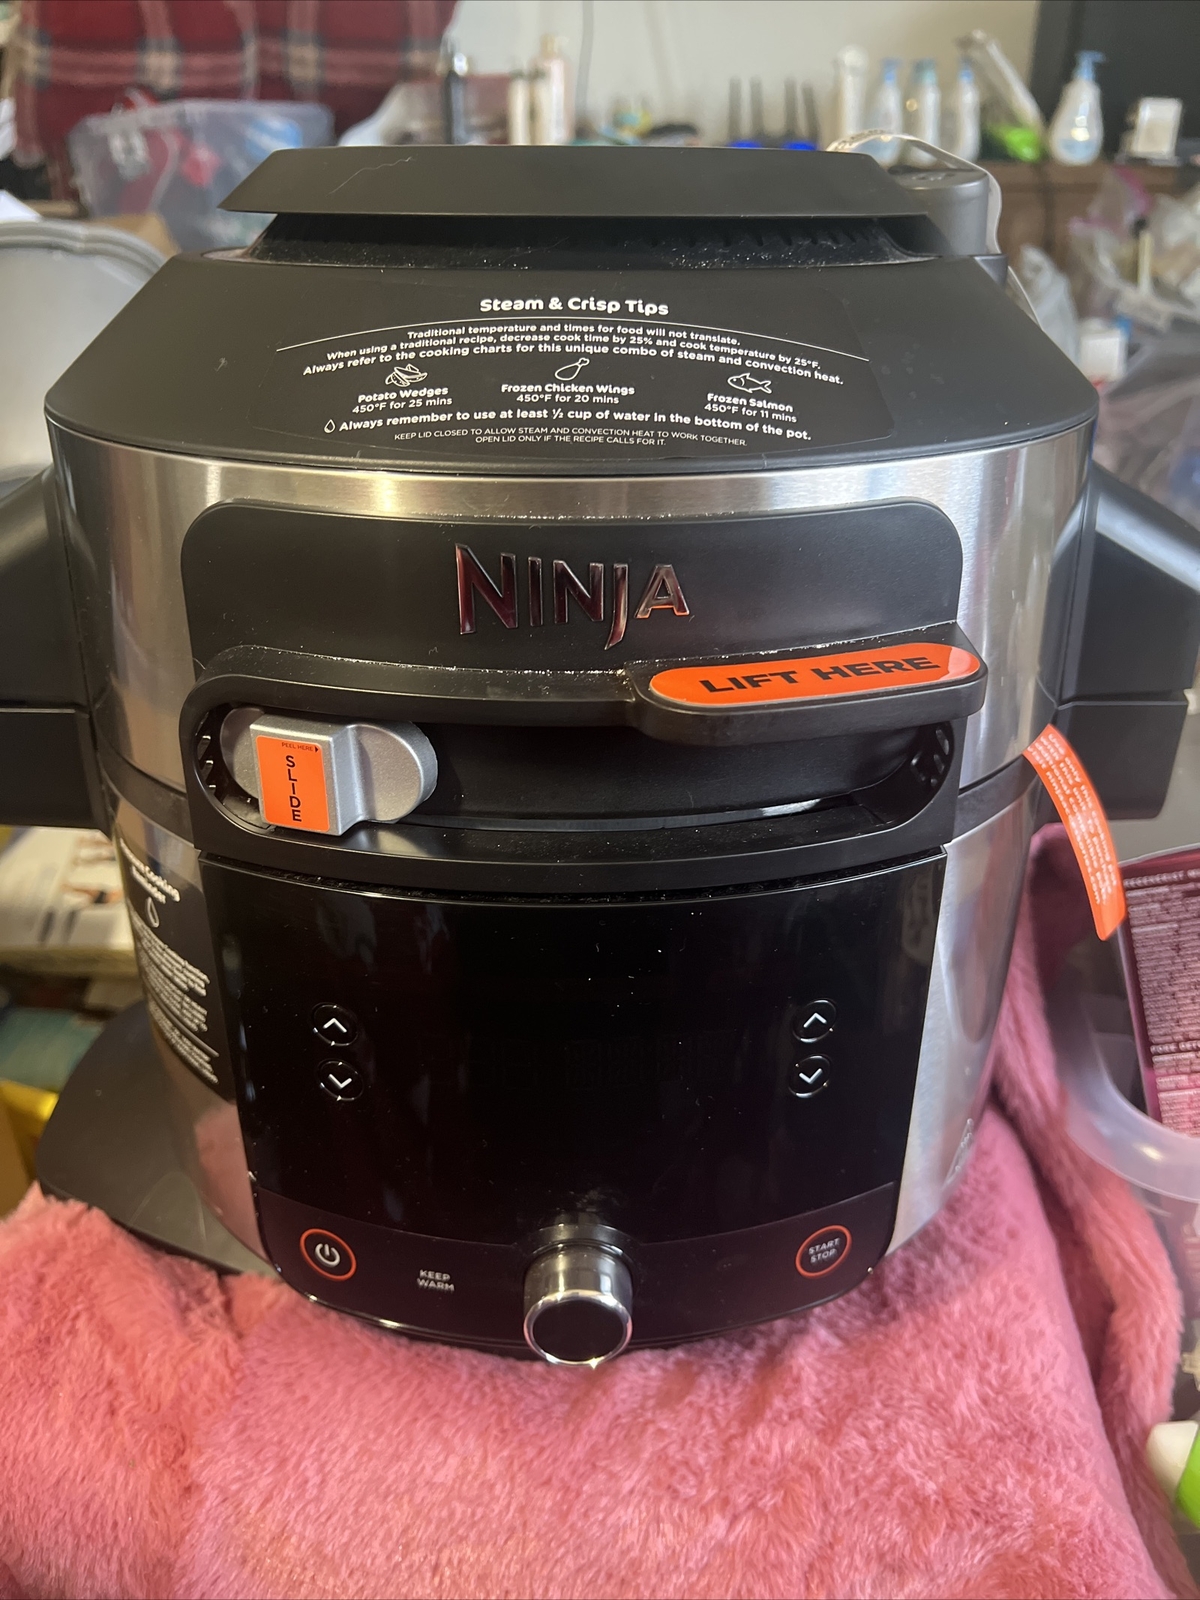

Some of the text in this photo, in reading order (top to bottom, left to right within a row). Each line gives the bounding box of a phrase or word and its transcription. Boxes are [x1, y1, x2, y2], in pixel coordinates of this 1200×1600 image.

[480, 296, 669, 317] Steam & Crisp Tips
[407, 323, 741, 345] Traditional temperature and times for food will not translate.
[327, 349, 357, 361] When
[360, 345, 388, 355] using
[390, 343, 397, 351] a
[400, 337, 456, 349] traditional
[459, 335, 497, 344] recipe,
[500, 334, 550, 342] decrease
[553, 334, 581, 342] cook
[584, 334, 609, 343] time
[612, 335, 626, 344] by
[629, 336, 653, 345] 25%
[655, 339, 676, 347] and
[679, 341, 707, 350] cook
[709, 343, 776, 360] temperature
[778, 354, 792, 364] by
[303, 343, 844, 385] Always refer to the cooking charts for this unique combo of steam and convection heat.
[358, 387, 449, 403] Potato Wedges
[501, 383, 635, 396] Frozen Chicken Wings
[516, 394, 619, 404] 450°F for 20 mins
[352, 397, 453, 414] 450°F for 25 mins
[704, 403, 797, 423] 450°F for 11 mins
[707, 393, 794, 413] Frozen Salmon
[339, 419, 383, 432] Always
[386, 412, 453, 426] remember
[456, 411, 470, 421] to
[473, 410, 496, 419] use
[500, 409, 513, 419] at
[517, 408, 548, 419] least
[567, 410, 592, 420] cup
[595, 410, 610, 420] of
[613, 411, 651, 422] water
[654, 412, 666, 422] in
[669, 413, 691, 424] the
[694, 415, 742, 430] bottom
[746, 422, 759, 432] of
[762, 424, 783, 436] the
[786, 429, 812, 441] pot.
[394, 432, 416, 440] KEEP
[418, 431, 432, 439] LID
[434, 429, 468, 437] CLOSED
[484, 427, 517, 435] ALLOW
[550, 427, 570, 435] AND
[571, 427, 630, 436] CONVECTION
[632, 429, 654, 437] HEAT
[657, 430, 669, 438] TO
[671, 431, 698, 440] WORK
[700, 434, 747, 446] TOGETHER.
[475, 435, 500, 443] OPEN
[518, 434, 541, 442] ONLY
[543, 434, 552, 442] IF
[553, 434, 571, 442] THE
[573, 435, 604, 443] RECIPE
[606, 436, 634, 444] CALLS
[636, 437, 655, 445] FOR
[657, 438, 666, 446] IT.
[455, 543, 690, 650] NINJA
[699, 656, 940, 693] LIFT HERE
[285, 755, 302, 822] SLIDE
[1048, 733, 1117, 886] Use only this cooking pot
[808, 1237, 840, 1255] START
[810, 1248, 837, 1264] STOP
[416, 1278, 455, 1293] WARM
[419, 1269, 451, 1282] KEEP
